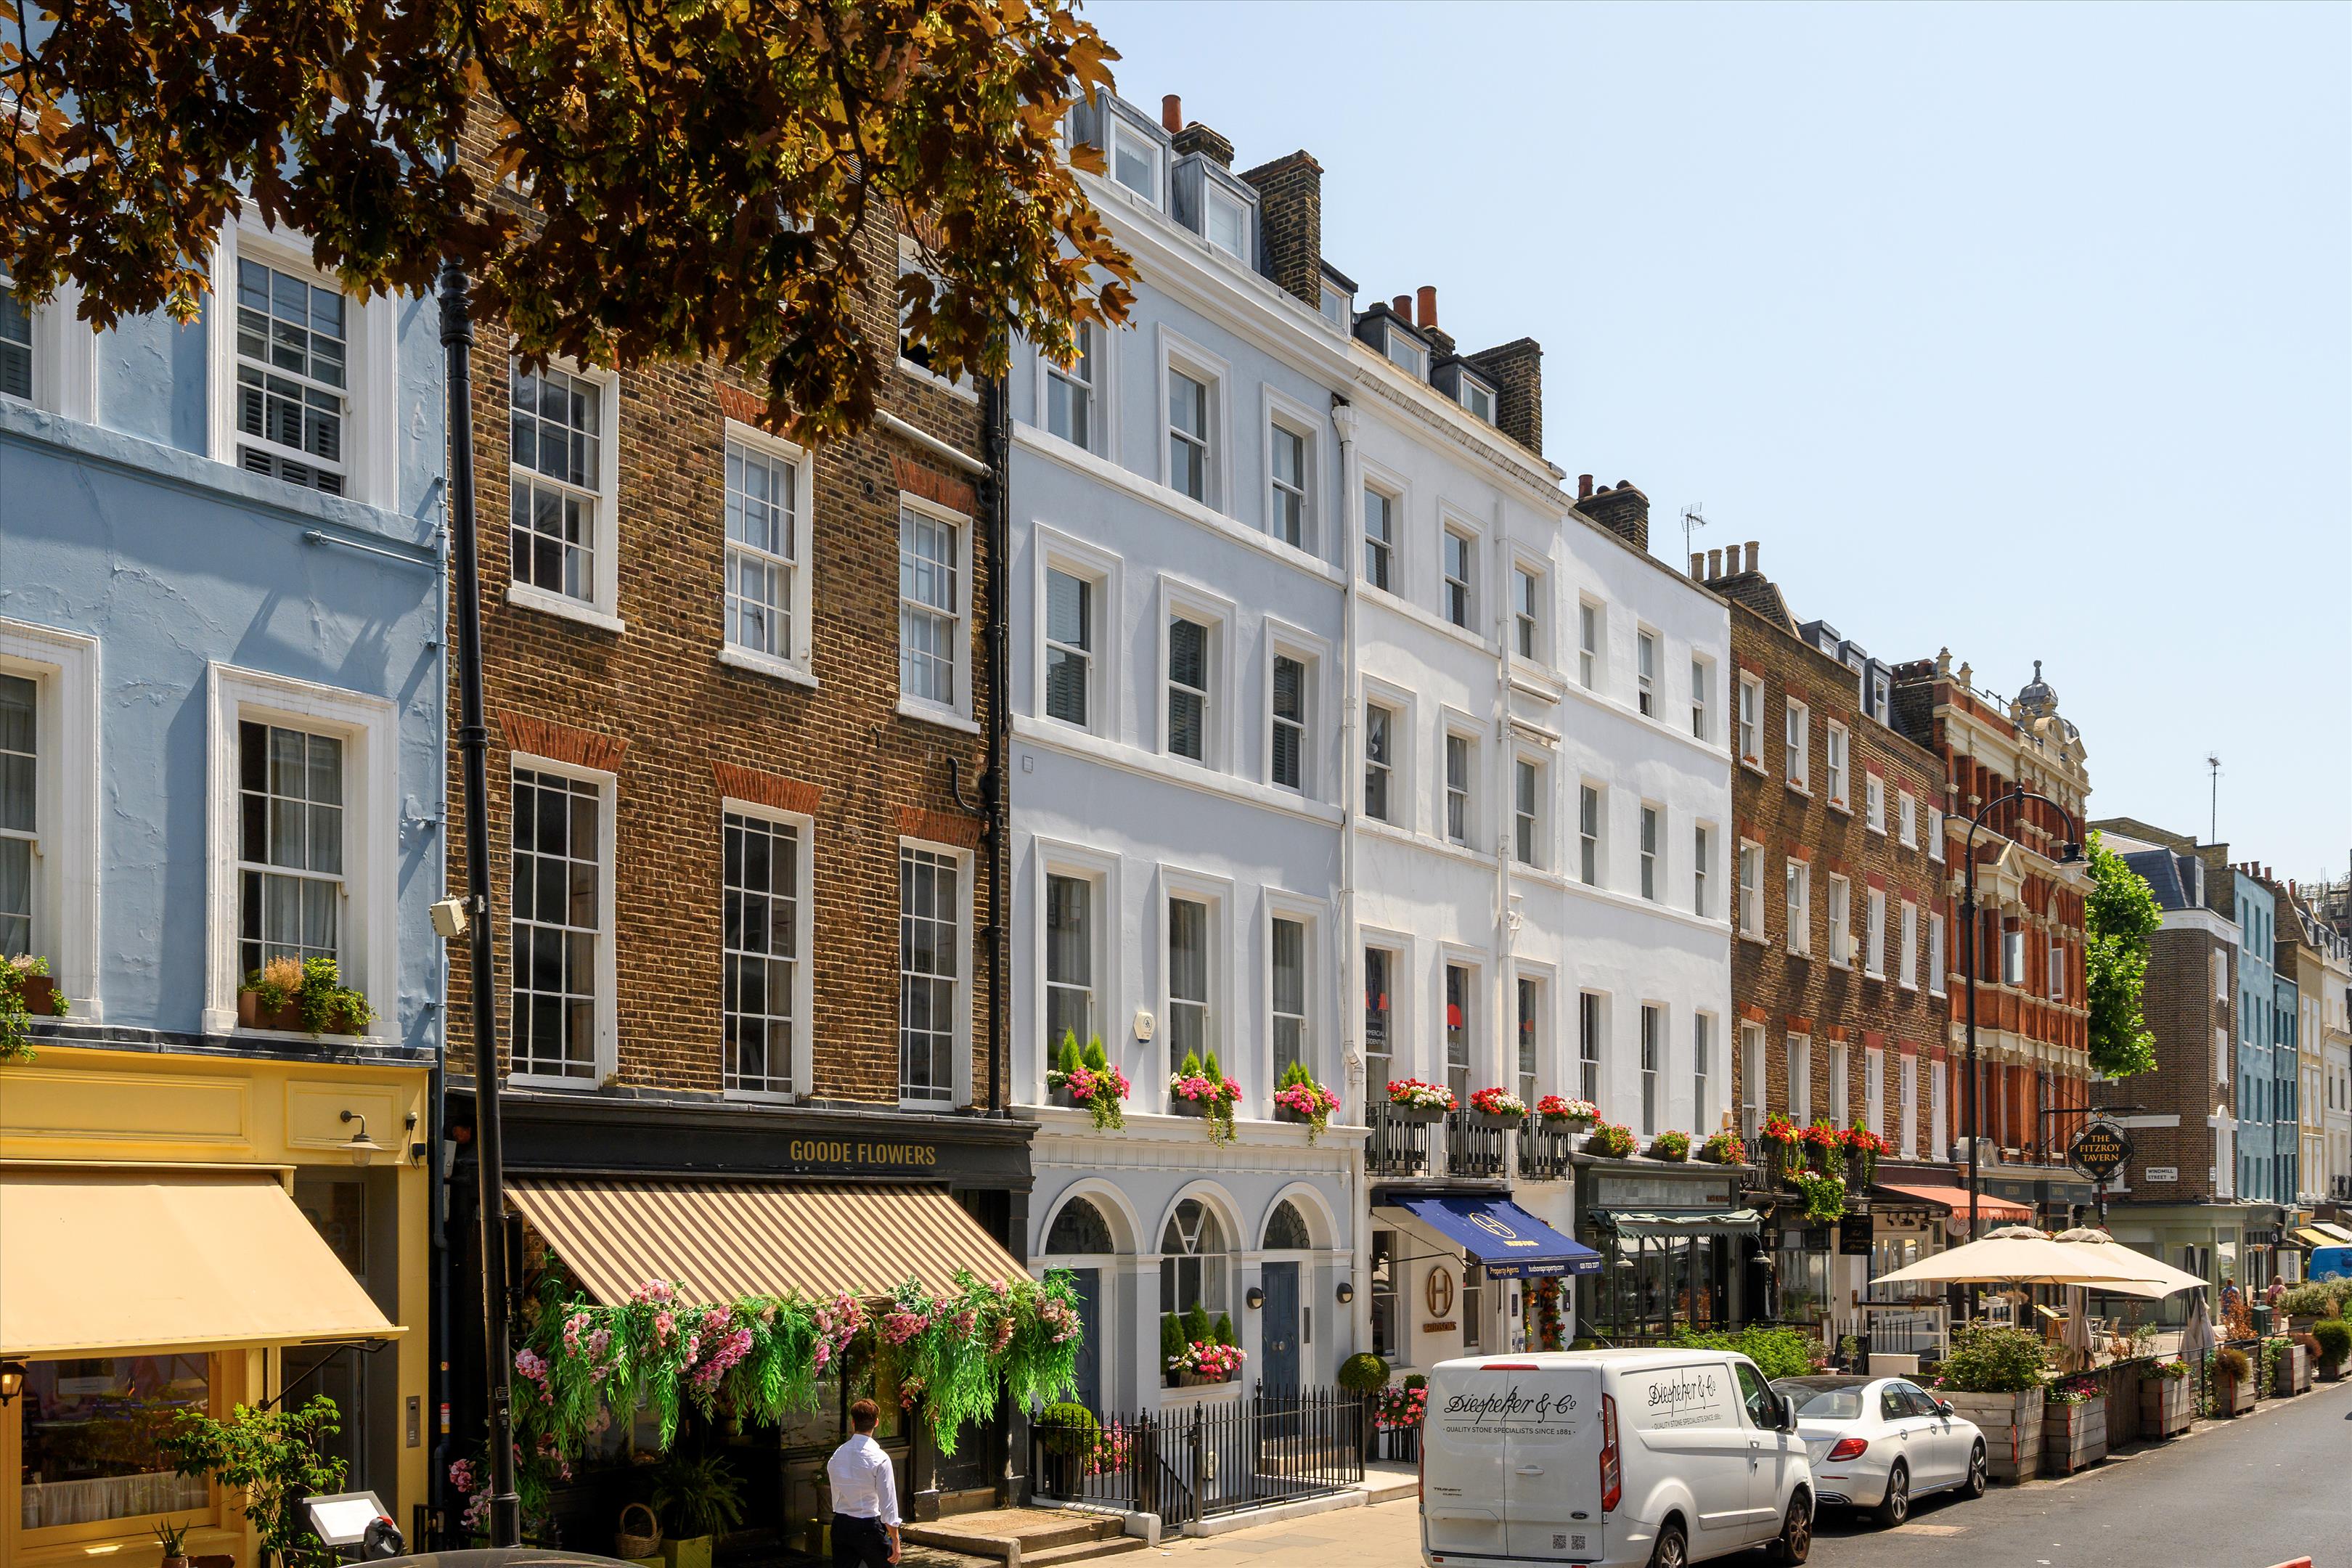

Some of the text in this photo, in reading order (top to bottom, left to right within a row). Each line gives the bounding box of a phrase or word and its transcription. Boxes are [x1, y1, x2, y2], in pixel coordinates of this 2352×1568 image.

[791, 1140, 936, 1165] GOODE FLOWERS
[2080, 1143, 2121, 1153] FITZROY
[2082, 1153, 2119, 1162] TAVERN
[1490, 1266, 1519, 1276] Property Agents
[1423, 1321, 1456, 1333] HUDSONS
[1648, 1368, 1696, 1417] Diespeker
[1698, 1374, 1706, 1410] &
[1444, 1385, 1535, 1426] Diespeker
[1535, 1392, 1551, 1424] &
[1654, 1421, 1670, 1430] QUALITY
[1670, 1418, 1683, 1428] STONE
[1683, 1416, 1704, 1426] SPECIALISTS
